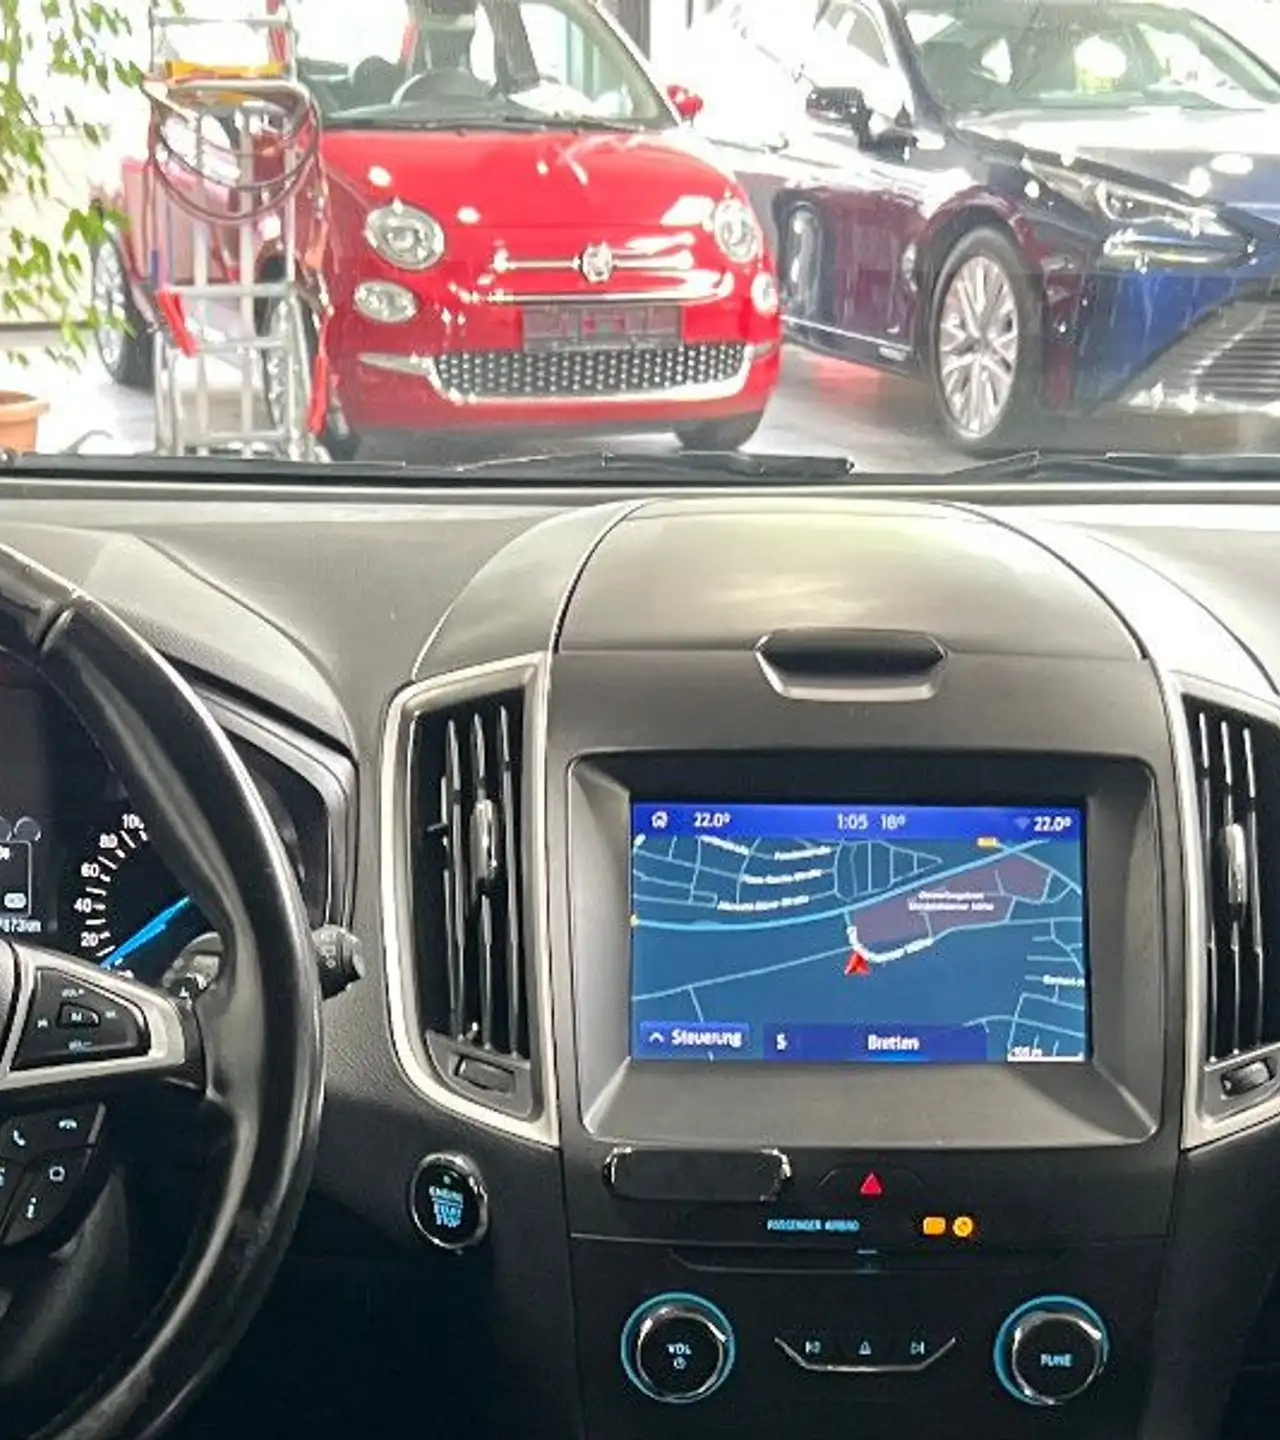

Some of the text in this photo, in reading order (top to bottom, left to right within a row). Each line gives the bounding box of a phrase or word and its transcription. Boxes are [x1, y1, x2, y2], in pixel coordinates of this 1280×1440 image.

[837, 814, 868, 830] 1:05
[99, 833, 118, 849] 80
[81, 862, 99, 877] 60
[73, 898, 92, 913] 40
[81, 931, 99, 947] 20
[672, 1028, 742, 1048] Steuerung
[869, 1034, 919, 1051] Bretten
[666, 1342, 692, 1355] VOL
